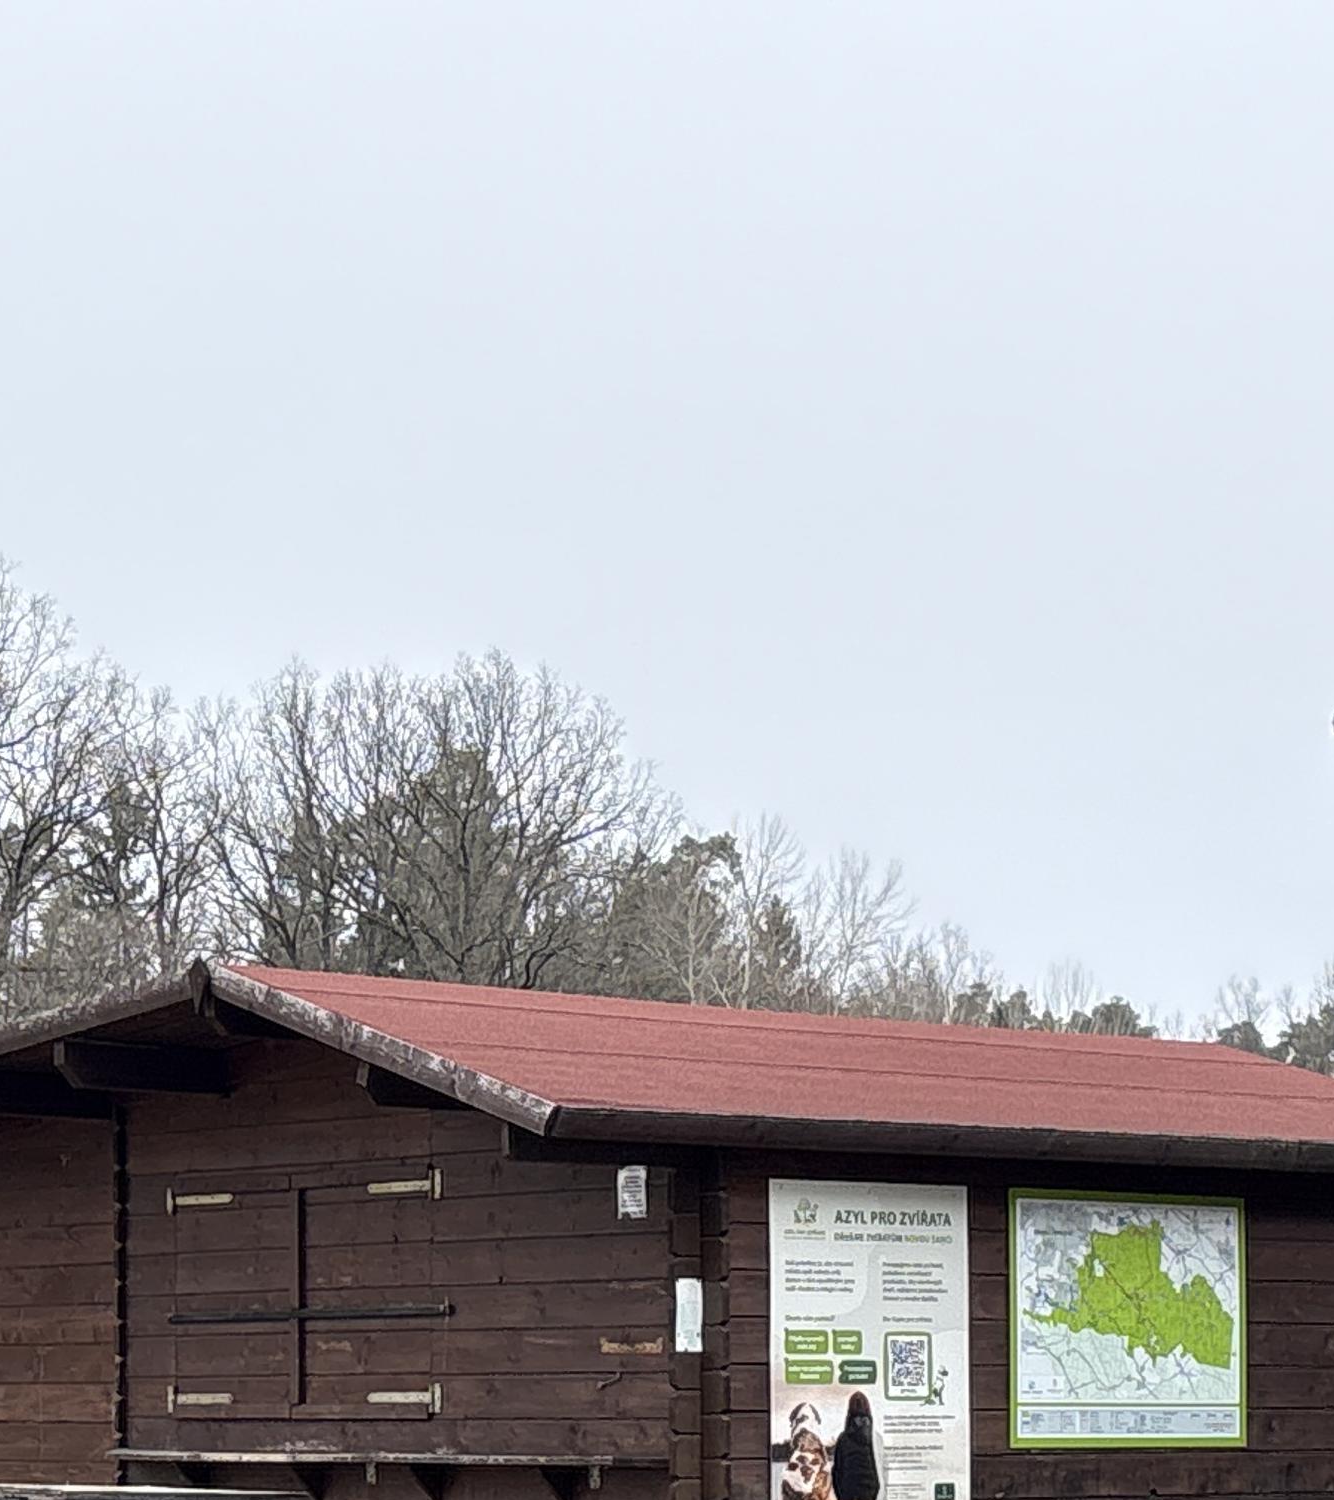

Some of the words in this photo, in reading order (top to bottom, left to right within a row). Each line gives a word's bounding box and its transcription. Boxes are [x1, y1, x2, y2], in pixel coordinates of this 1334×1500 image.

[834, 1210, 867, 1225] AZYL
[871, 1211, 896, 1226] PRO
[899, 1209, 952, 1227] ZVÍŘATA
